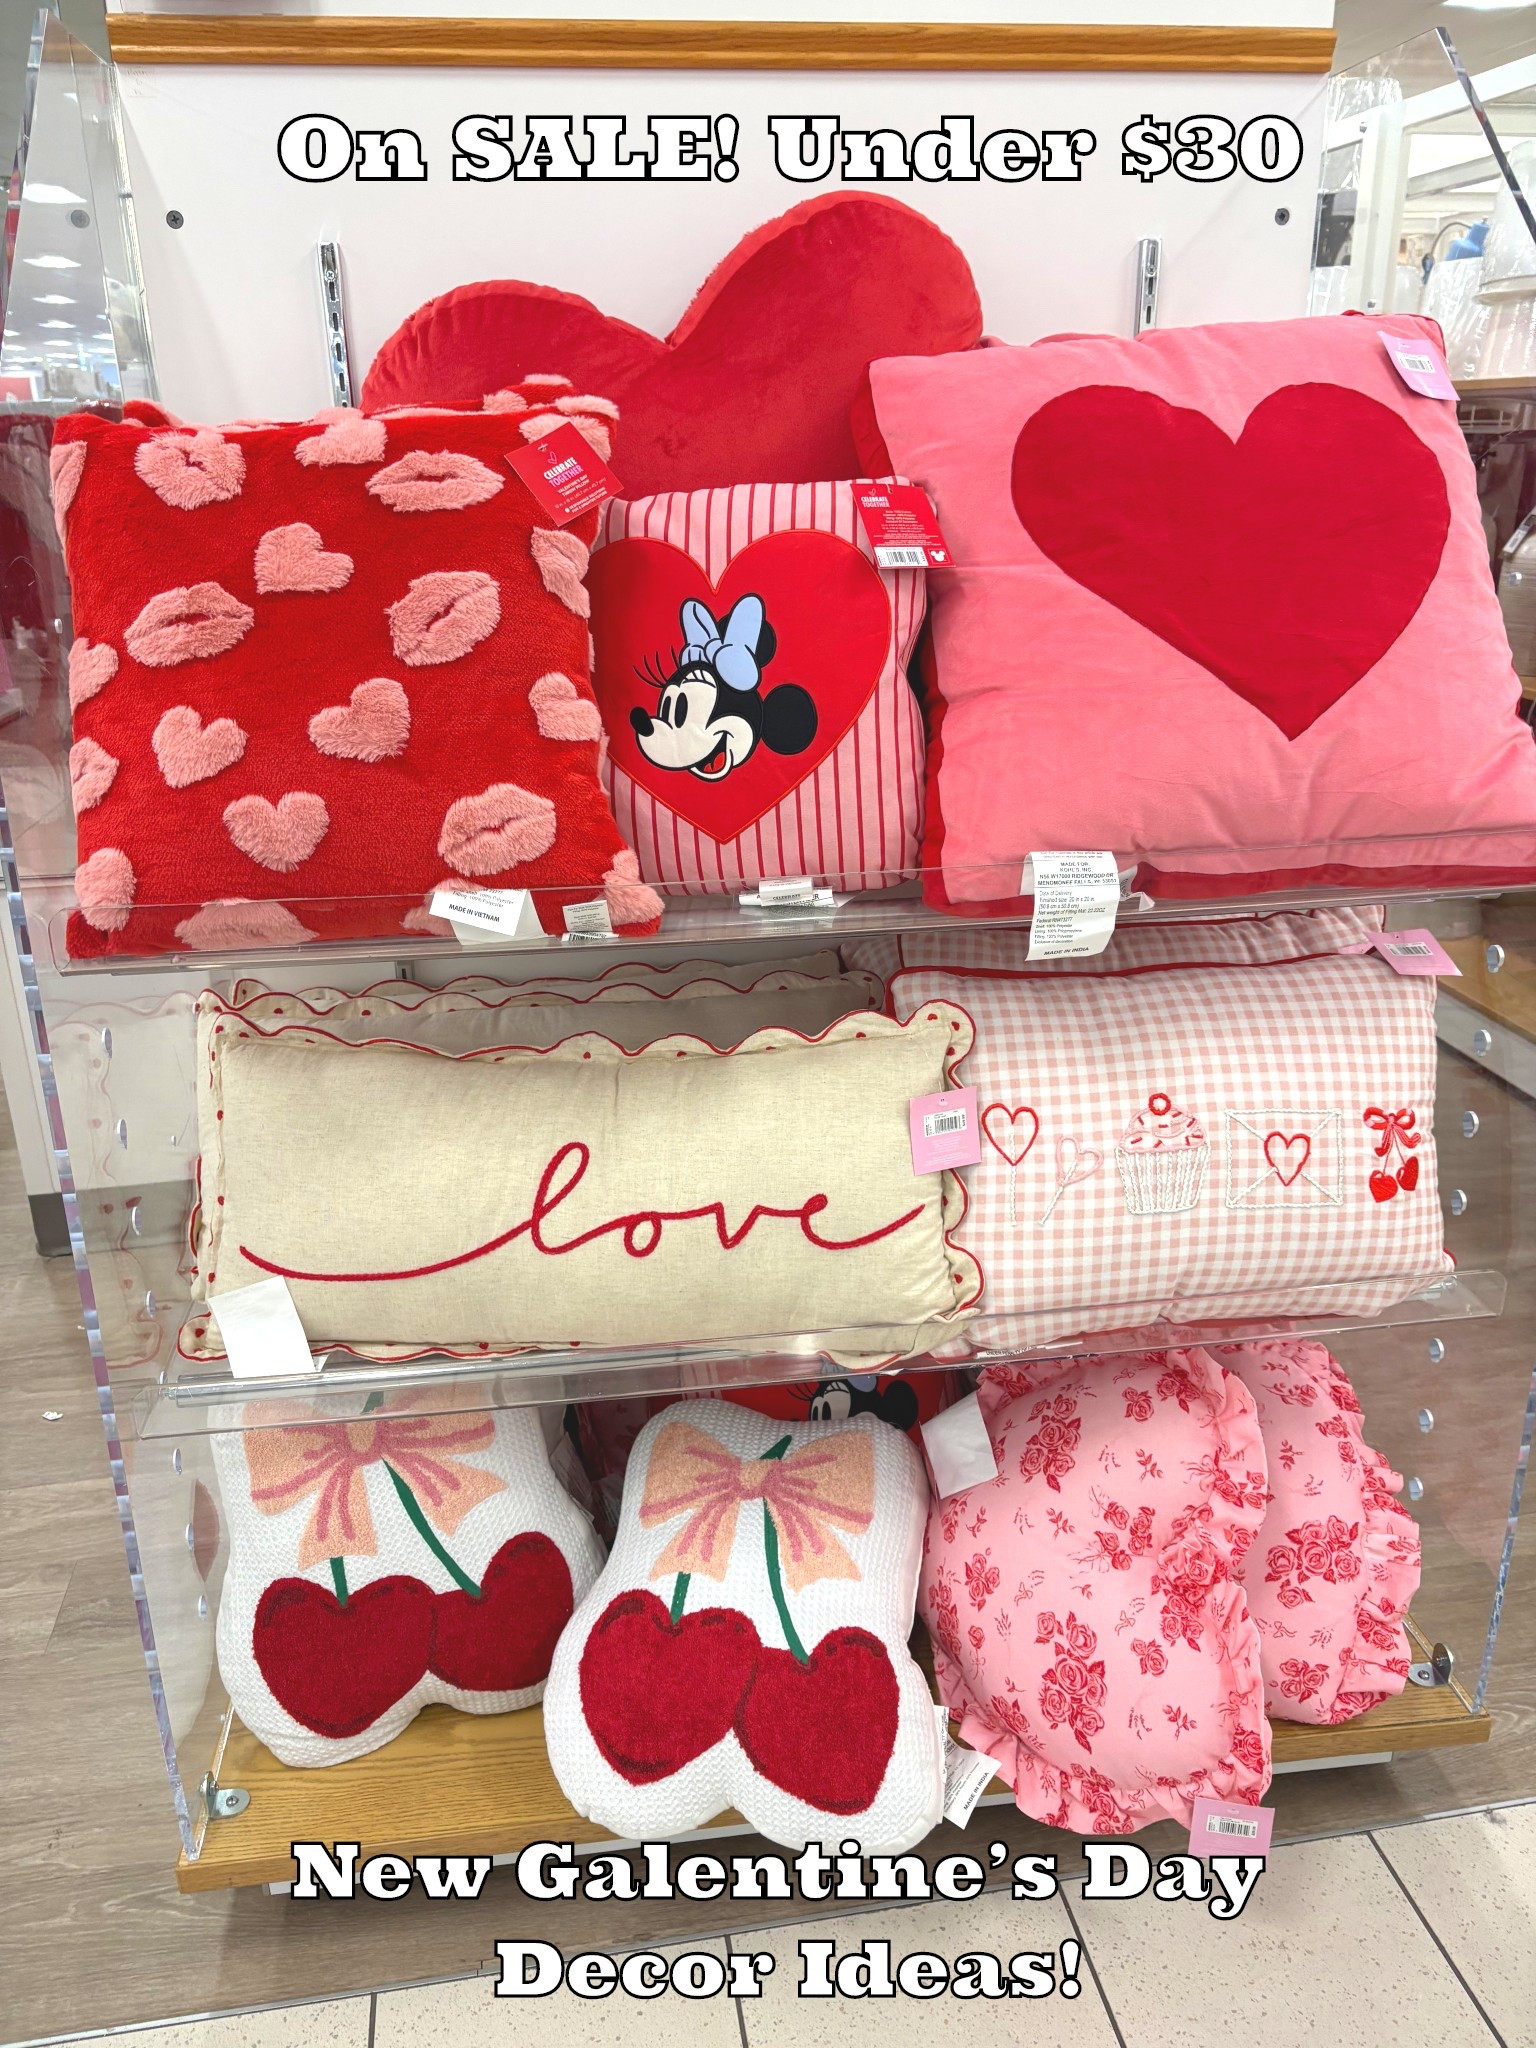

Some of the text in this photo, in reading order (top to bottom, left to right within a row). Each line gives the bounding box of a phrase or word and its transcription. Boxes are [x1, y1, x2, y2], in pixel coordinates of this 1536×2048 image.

[544, 457, 577, 480] CELEBRATE
[549, 464, 584, 487] TOGETHER
[772, 893, 801, 901] CELEBRATE
[449, 904, 467, 913] MADE
[474, 910, 500, 922] VIETNAM
[963, 1771, 990, 1811] MADE IN INDIA
